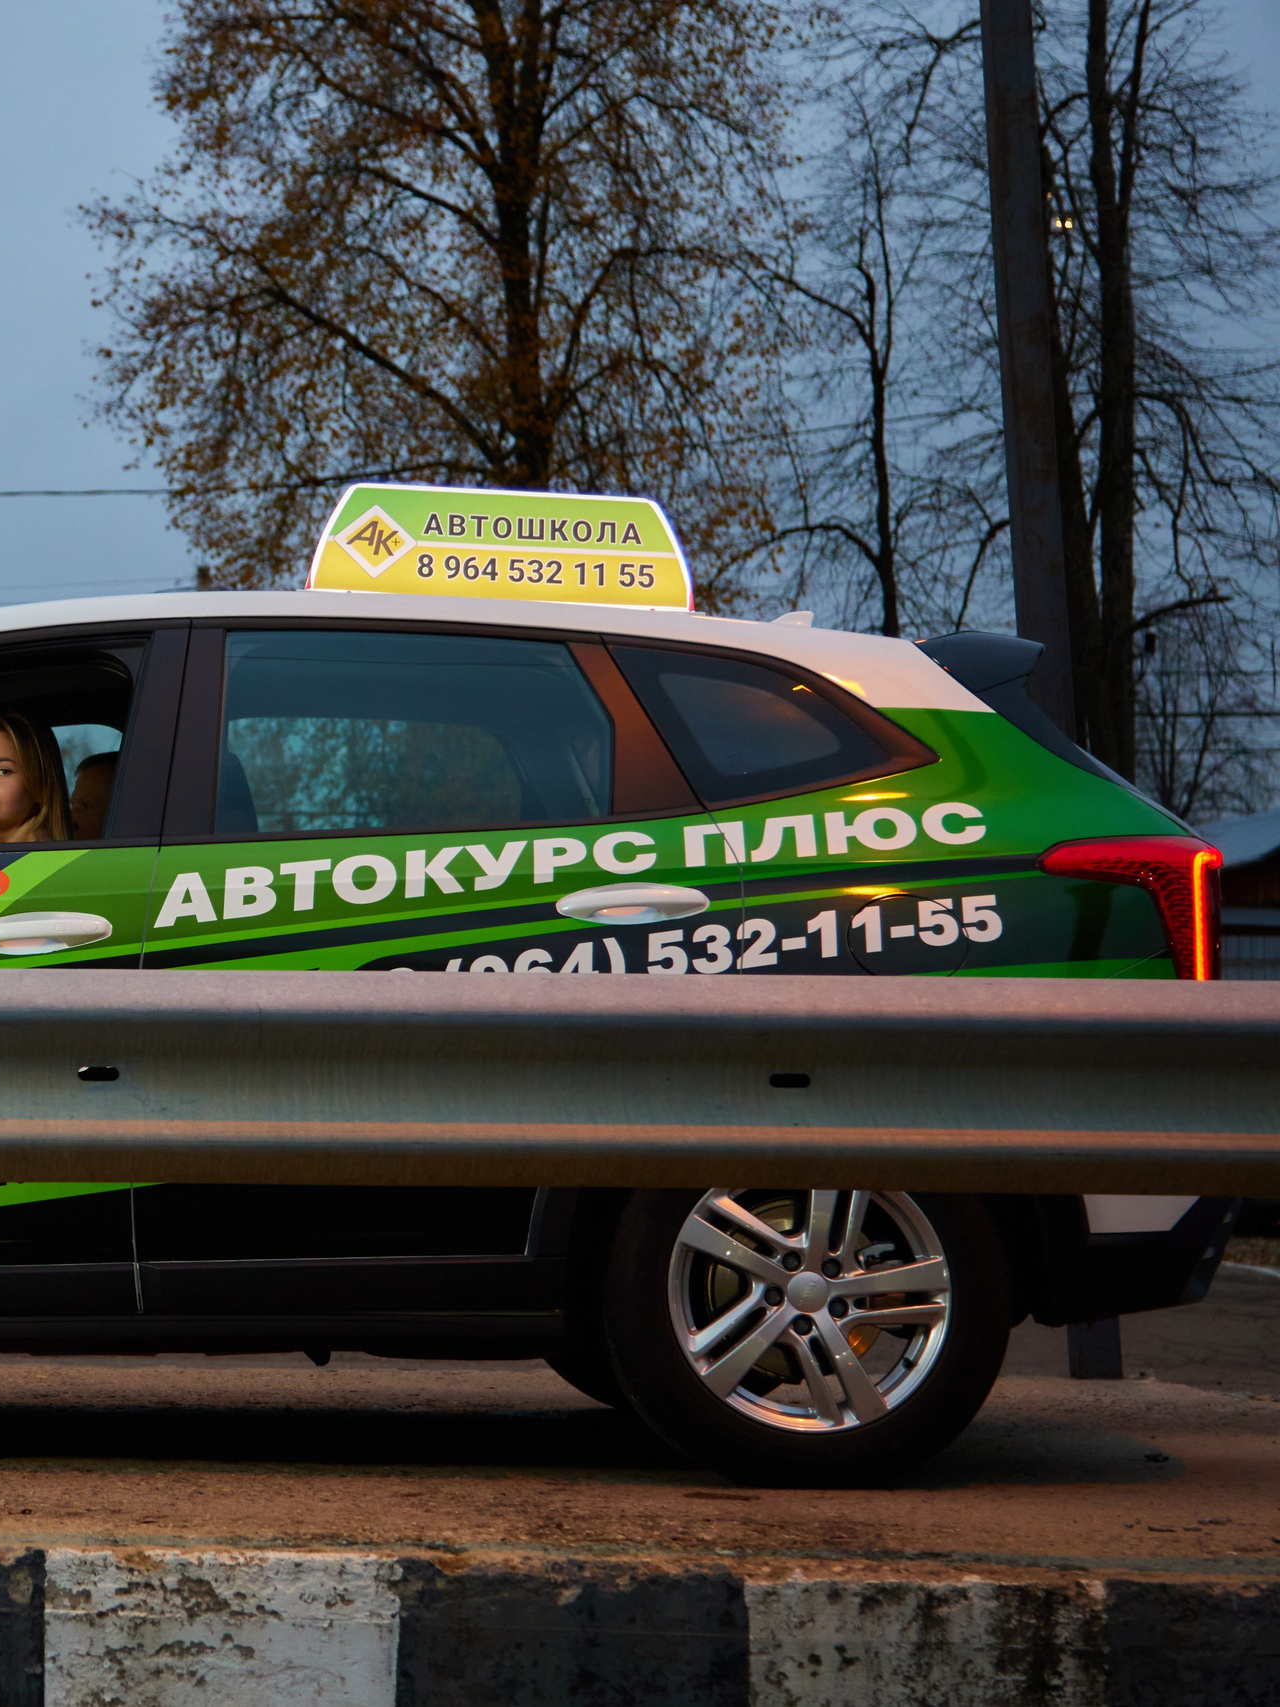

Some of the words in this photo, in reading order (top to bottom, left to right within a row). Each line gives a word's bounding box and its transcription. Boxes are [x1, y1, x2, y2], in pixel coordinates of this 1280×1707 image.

[422, 512, 643, 545] АВТОШКОЛА
[417, 554, 434, 578] 8
[444, 556, 498, 581] 964
[508, 559, 562, 585] 532
[575, 562, 605, 587] 11
[619, 564, 654, 588] 55
[154, 831, 657, 928] АВТОКУРС
[684, 802, 986, 867] ПЛЮС
[647, 895, 1003, 974] 532-11-55
